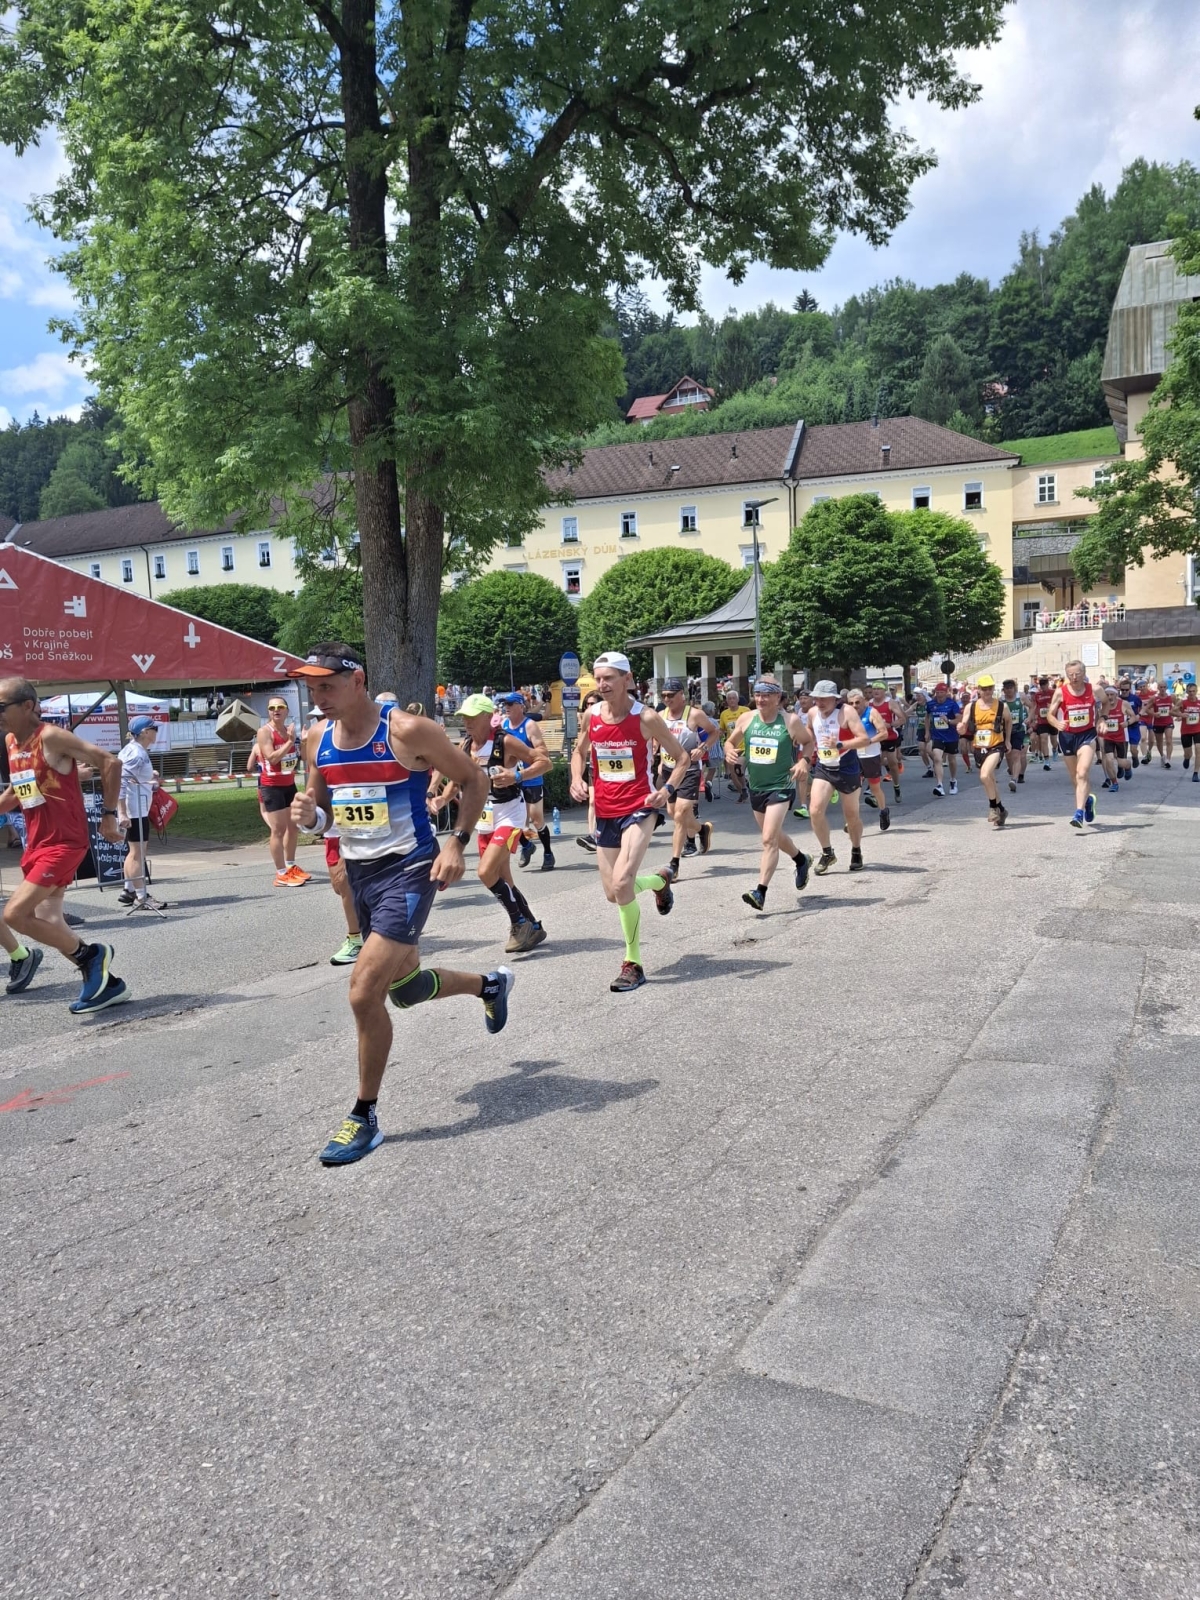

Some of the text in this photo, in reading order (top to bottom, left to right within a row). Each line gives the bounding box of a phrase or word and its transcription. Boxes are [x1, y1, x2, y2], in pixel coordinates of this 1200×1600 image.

[23, 627, 93, 640] Dobře pobejt
[32, 640, 70, 651] Krajině
[25, 651, 93, 662] pod Sněžkou
[755, 746, 771, 756] 508
[608, 759, 623, 770] 98
[18, 783, 31, 796] 279
[344, 805, 375, 822] 315
